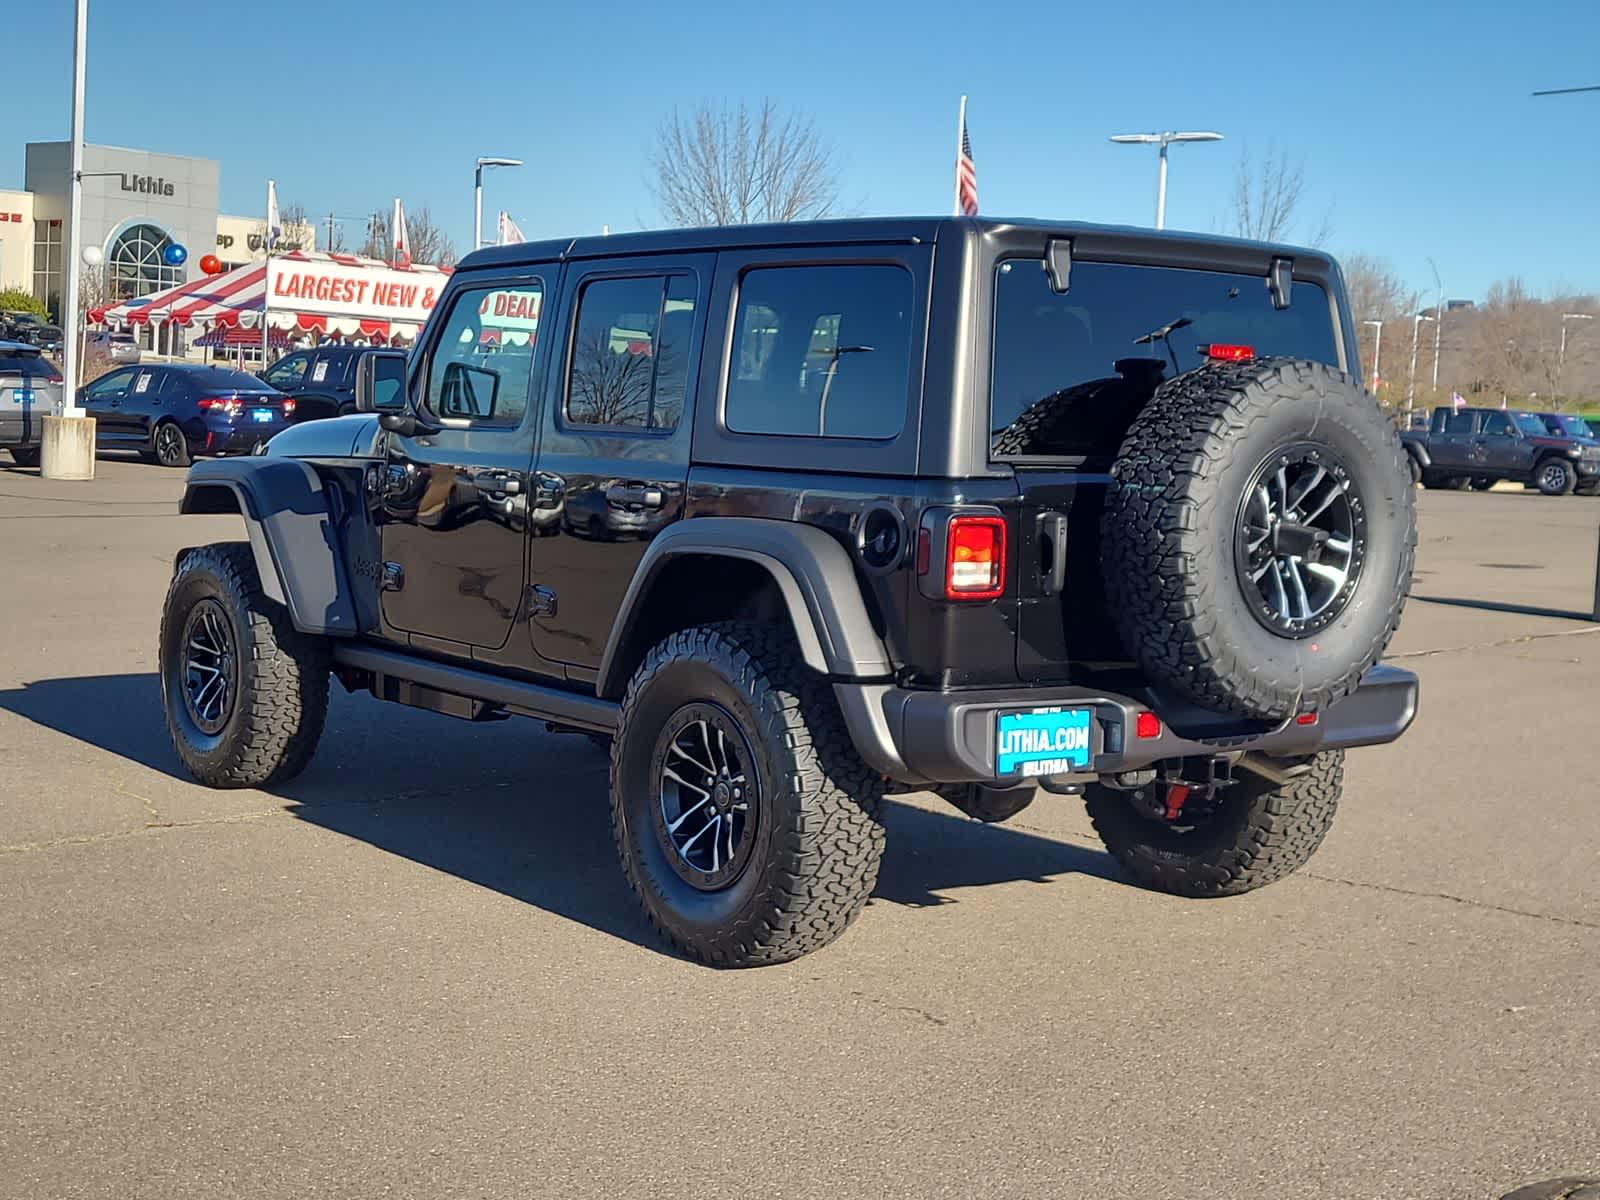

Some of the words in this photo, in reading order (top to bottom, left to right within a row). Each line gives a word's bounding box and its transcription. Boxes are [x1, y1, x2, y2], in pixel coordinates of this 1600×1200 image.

[121, 173, 175, 196] Lithia
[274, 271, 369, 303] LARGEST
[372, 281, 419, 308] NEW
[421, 287, 436, 309] &
[998, 726, 1088, 754] LITHIA.COM
